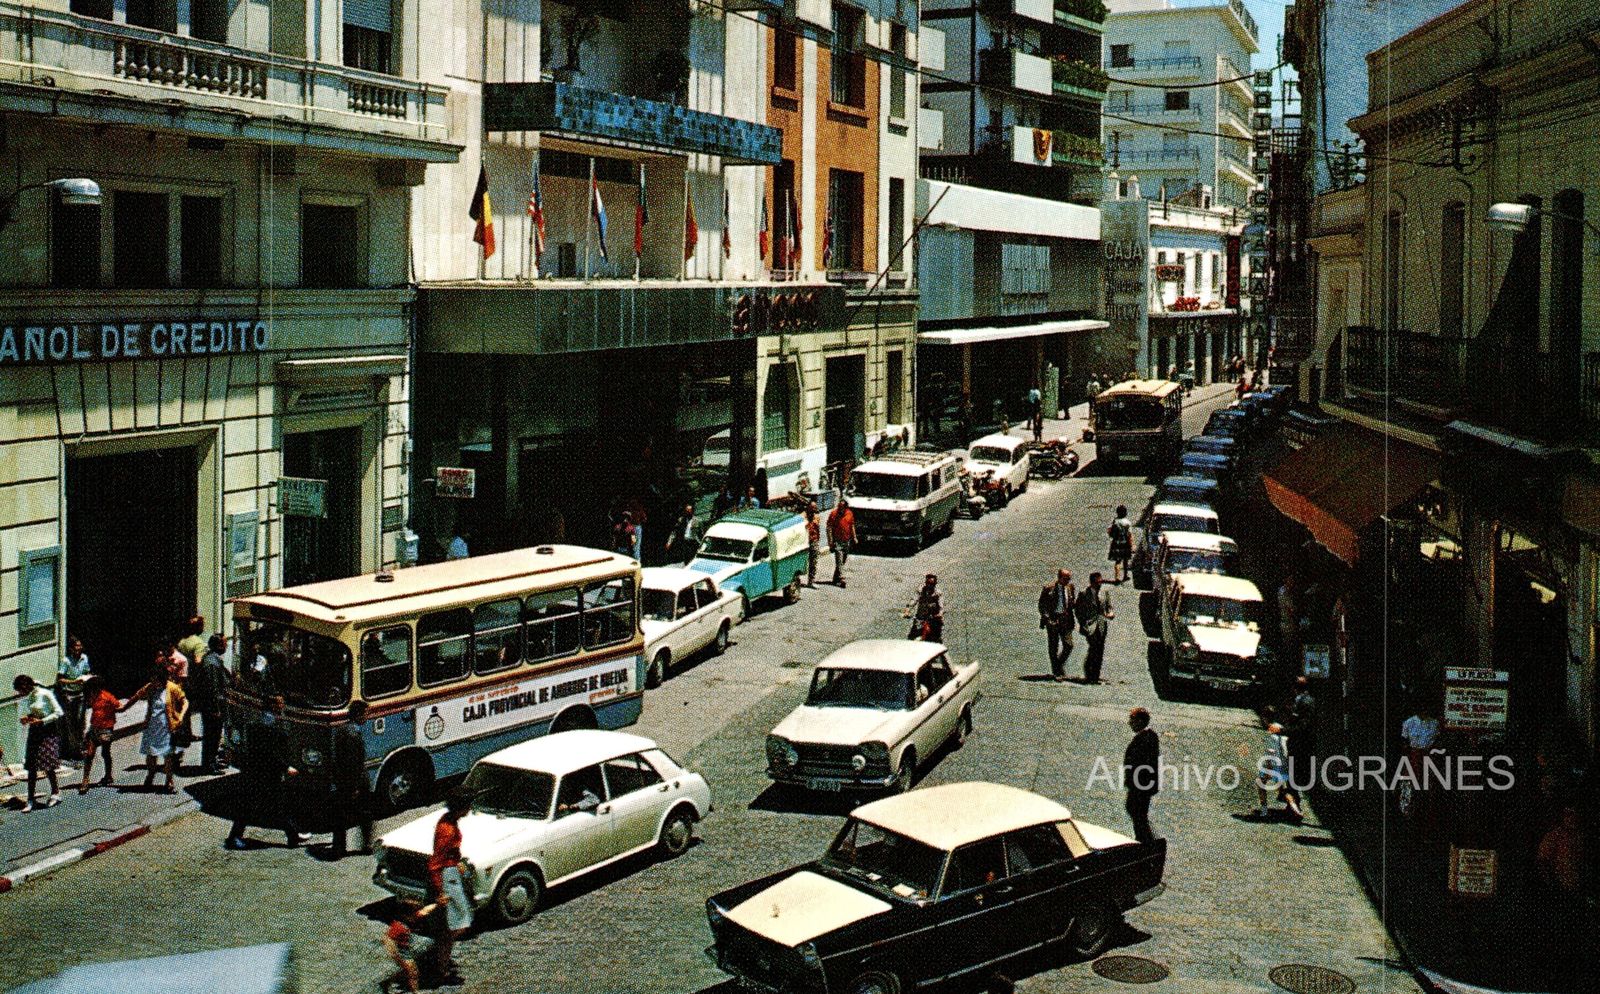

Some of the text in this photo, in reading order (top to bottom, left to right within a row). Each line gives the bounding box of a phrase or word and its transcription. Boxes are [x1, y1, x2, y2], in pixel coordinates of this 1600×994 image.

[1253, 71, 1271, 174] HOTEL
[1105, 241, 1143, 259] CAJA
[101, 324, 141, 357] DE
[150, 320, 271, 354] CREDITO
[463, 704, 487, 723] CAJA
[488, 690, 536, 717] PROVINCIAL
[539, 687, 550, 703] DE
[550, 678, 588, 699] AHORROS
[589, 675, 599, 690] DE
[599, 668, 628, 687] HUELVA
